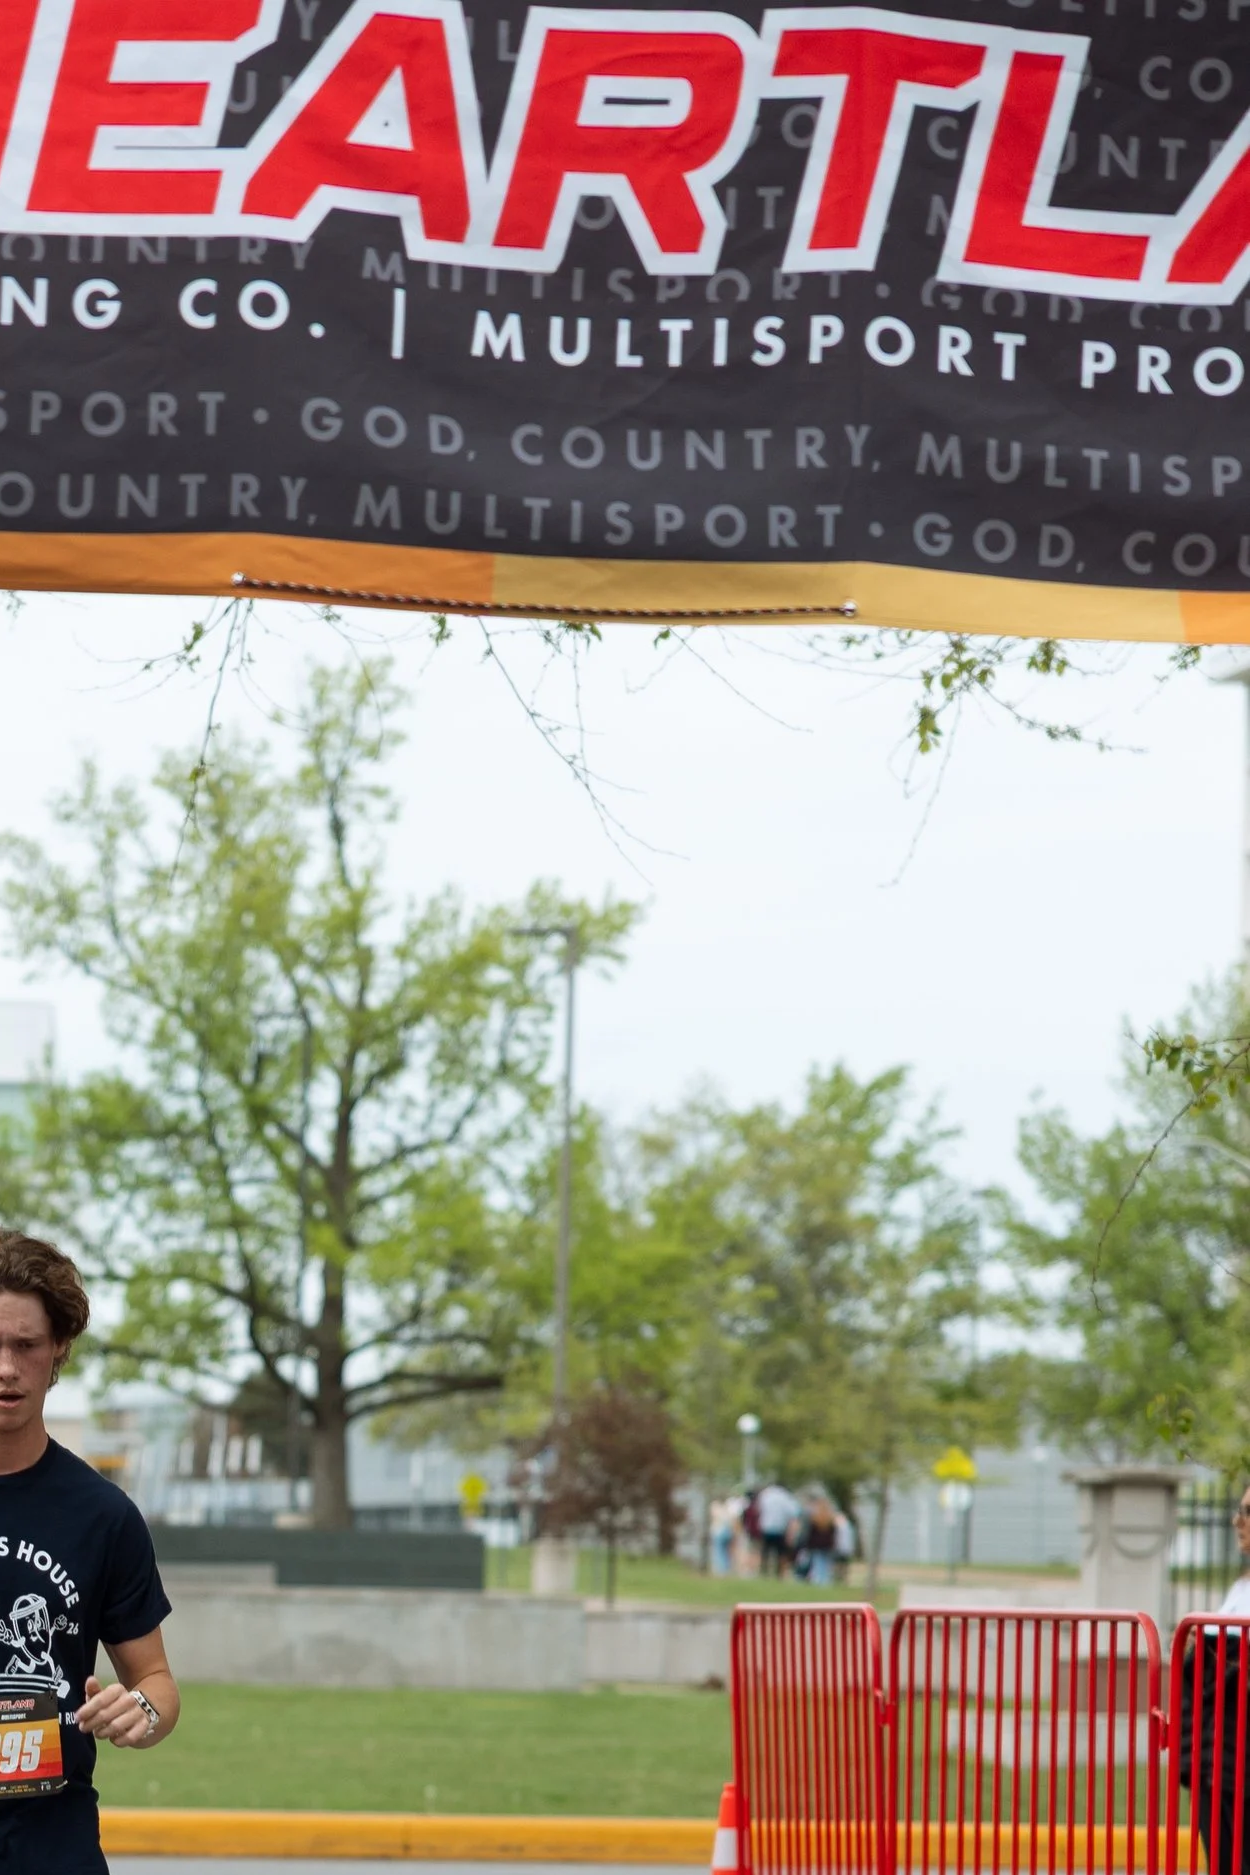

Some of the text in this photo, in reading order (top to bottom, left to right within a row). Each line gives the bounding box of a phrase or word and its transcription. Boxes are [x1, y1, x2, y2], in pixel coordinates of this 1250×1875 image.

[178, 278, 326, 338] CO.
[471, 310, 1027, 381] MULTISPORT
[1080, 339, 1245, 397] PRO
[301, 397, 477, 461] GOD,
[511, 424, 882, 472] COUNTRY,
[915, 432, 1243, 497] MULTISP
[353, 482, 843, 549] MULTISPORT
[912, 512, 1085, 572] GOD,
[16, 1539, 80, 1608] HOUSE
[66, 1622, 79, 1635] 26
[65, 1711, 79, 1725] RU
